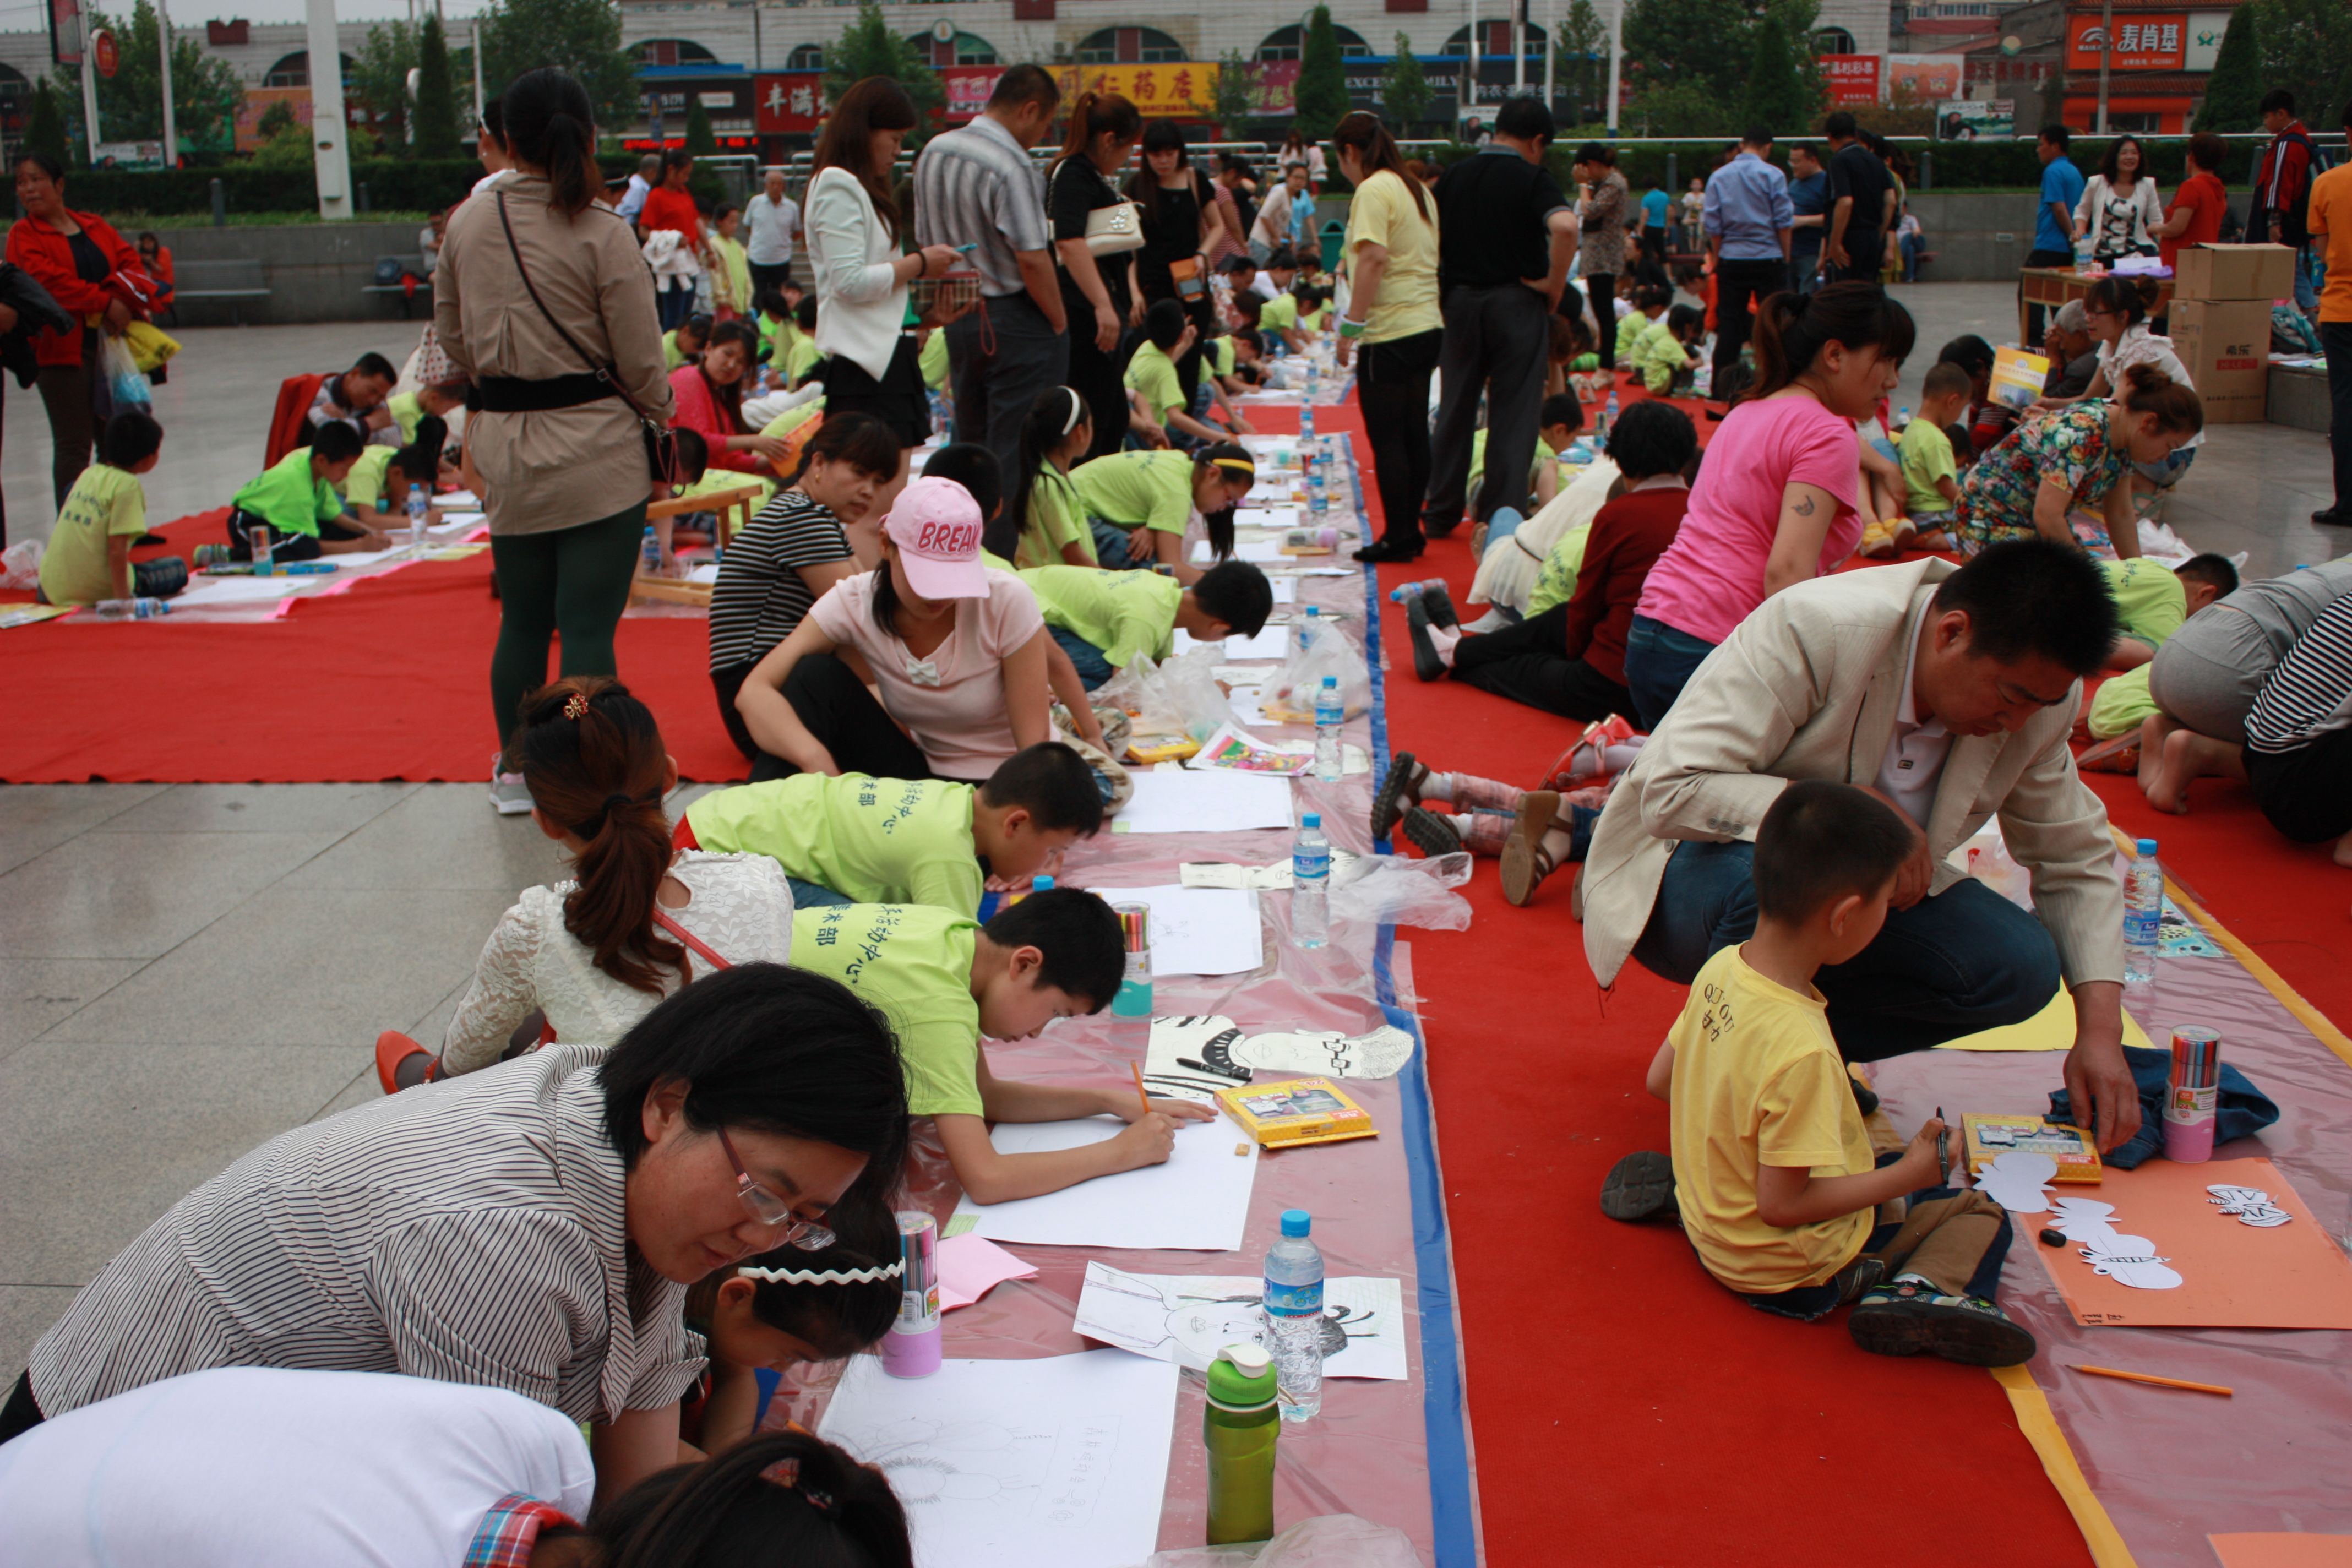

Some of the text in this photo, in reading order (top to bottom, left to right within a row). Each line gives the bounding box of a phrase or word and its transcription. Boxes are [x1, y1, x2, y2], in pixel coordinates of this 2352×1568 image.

[2116, 24, 2179, 52] 麦肯基
[918, 521, 982, 552] BREAK
[1704, 983, 1735, 1033] QUOU
